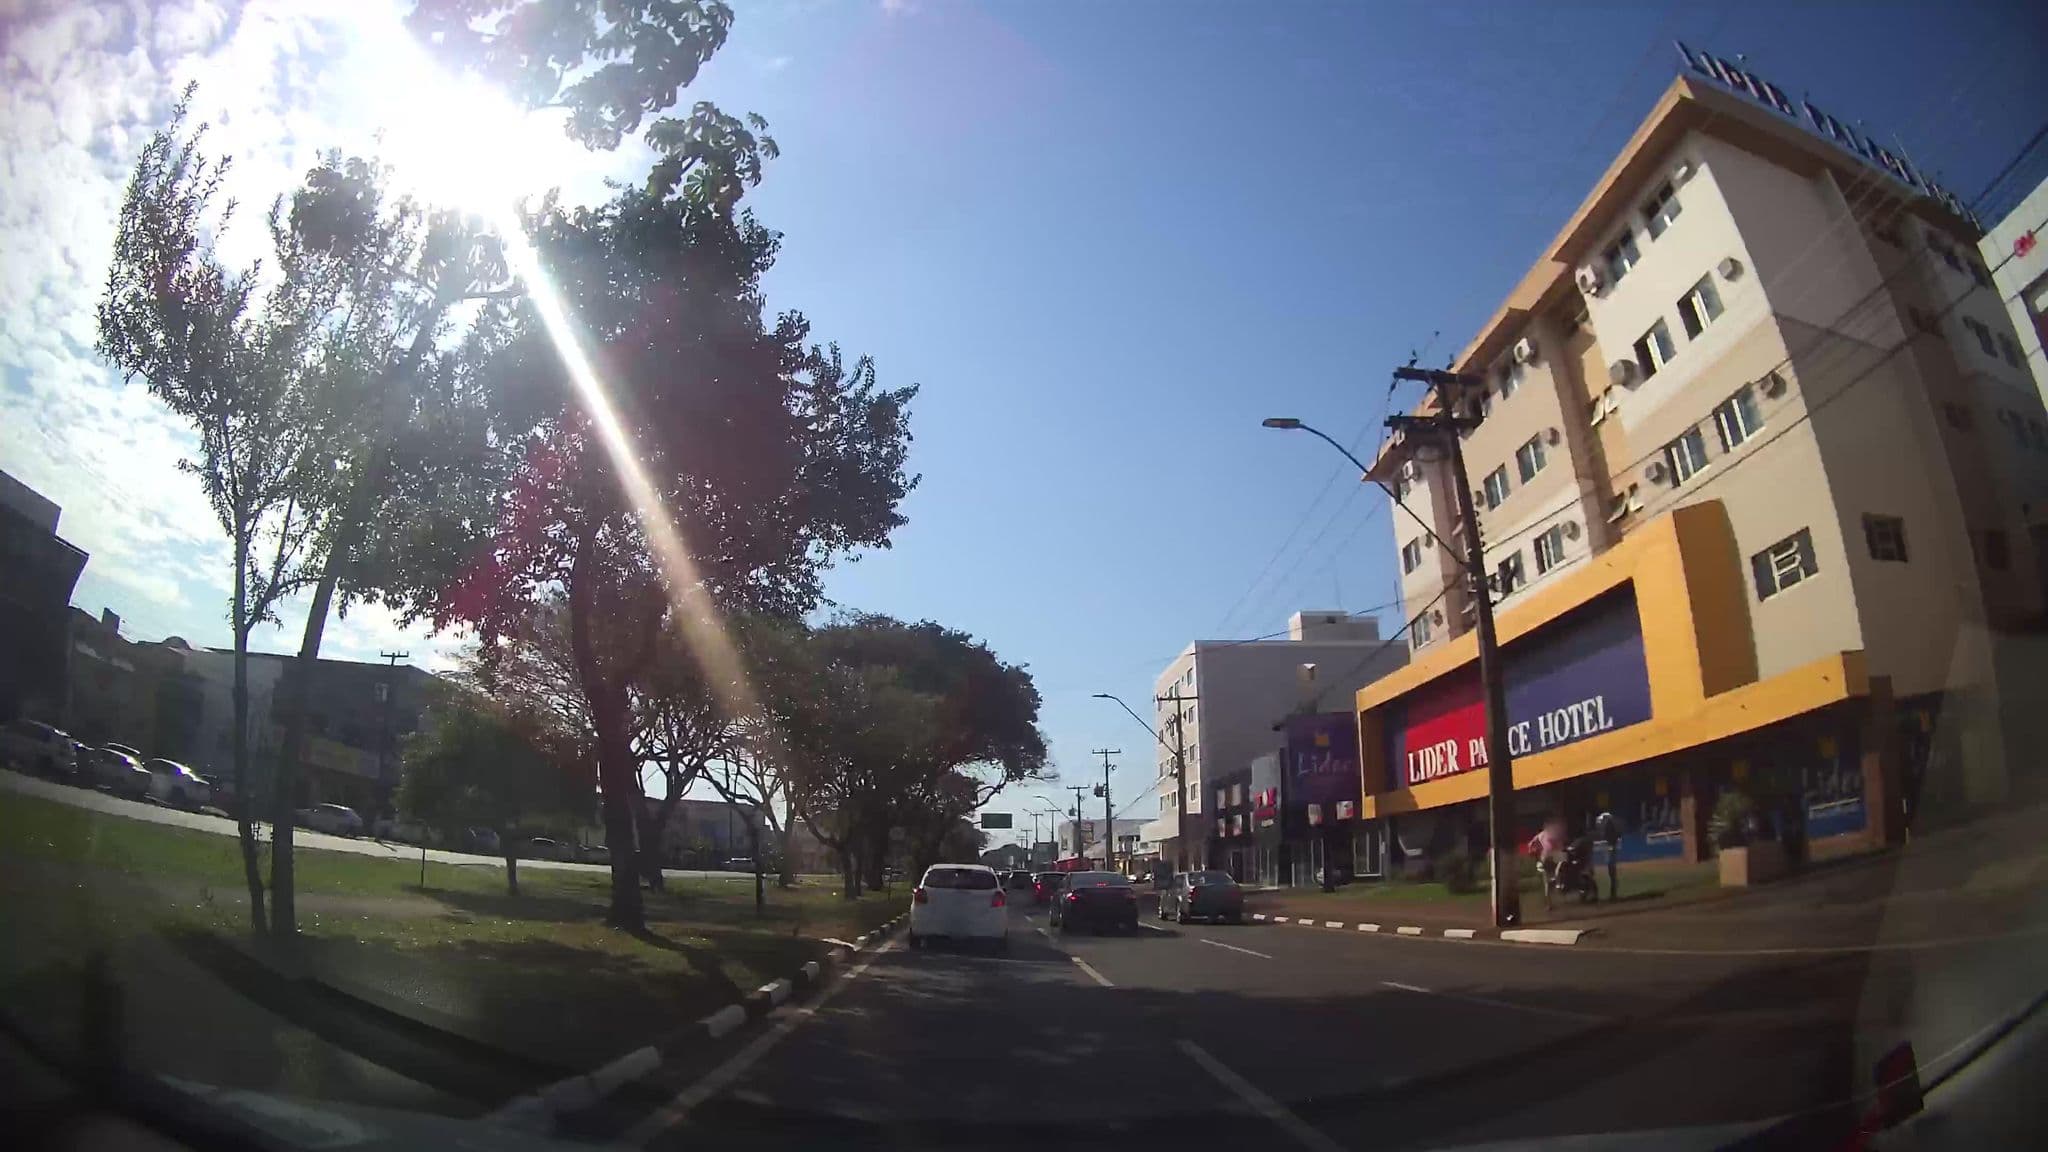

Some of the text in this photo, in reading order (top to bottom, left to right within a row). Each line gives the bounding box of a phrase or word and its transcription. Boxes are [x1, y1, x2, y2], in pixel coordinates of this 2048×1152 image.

[1408, 695, 1613, 782] LIDER PACE HOTEL
